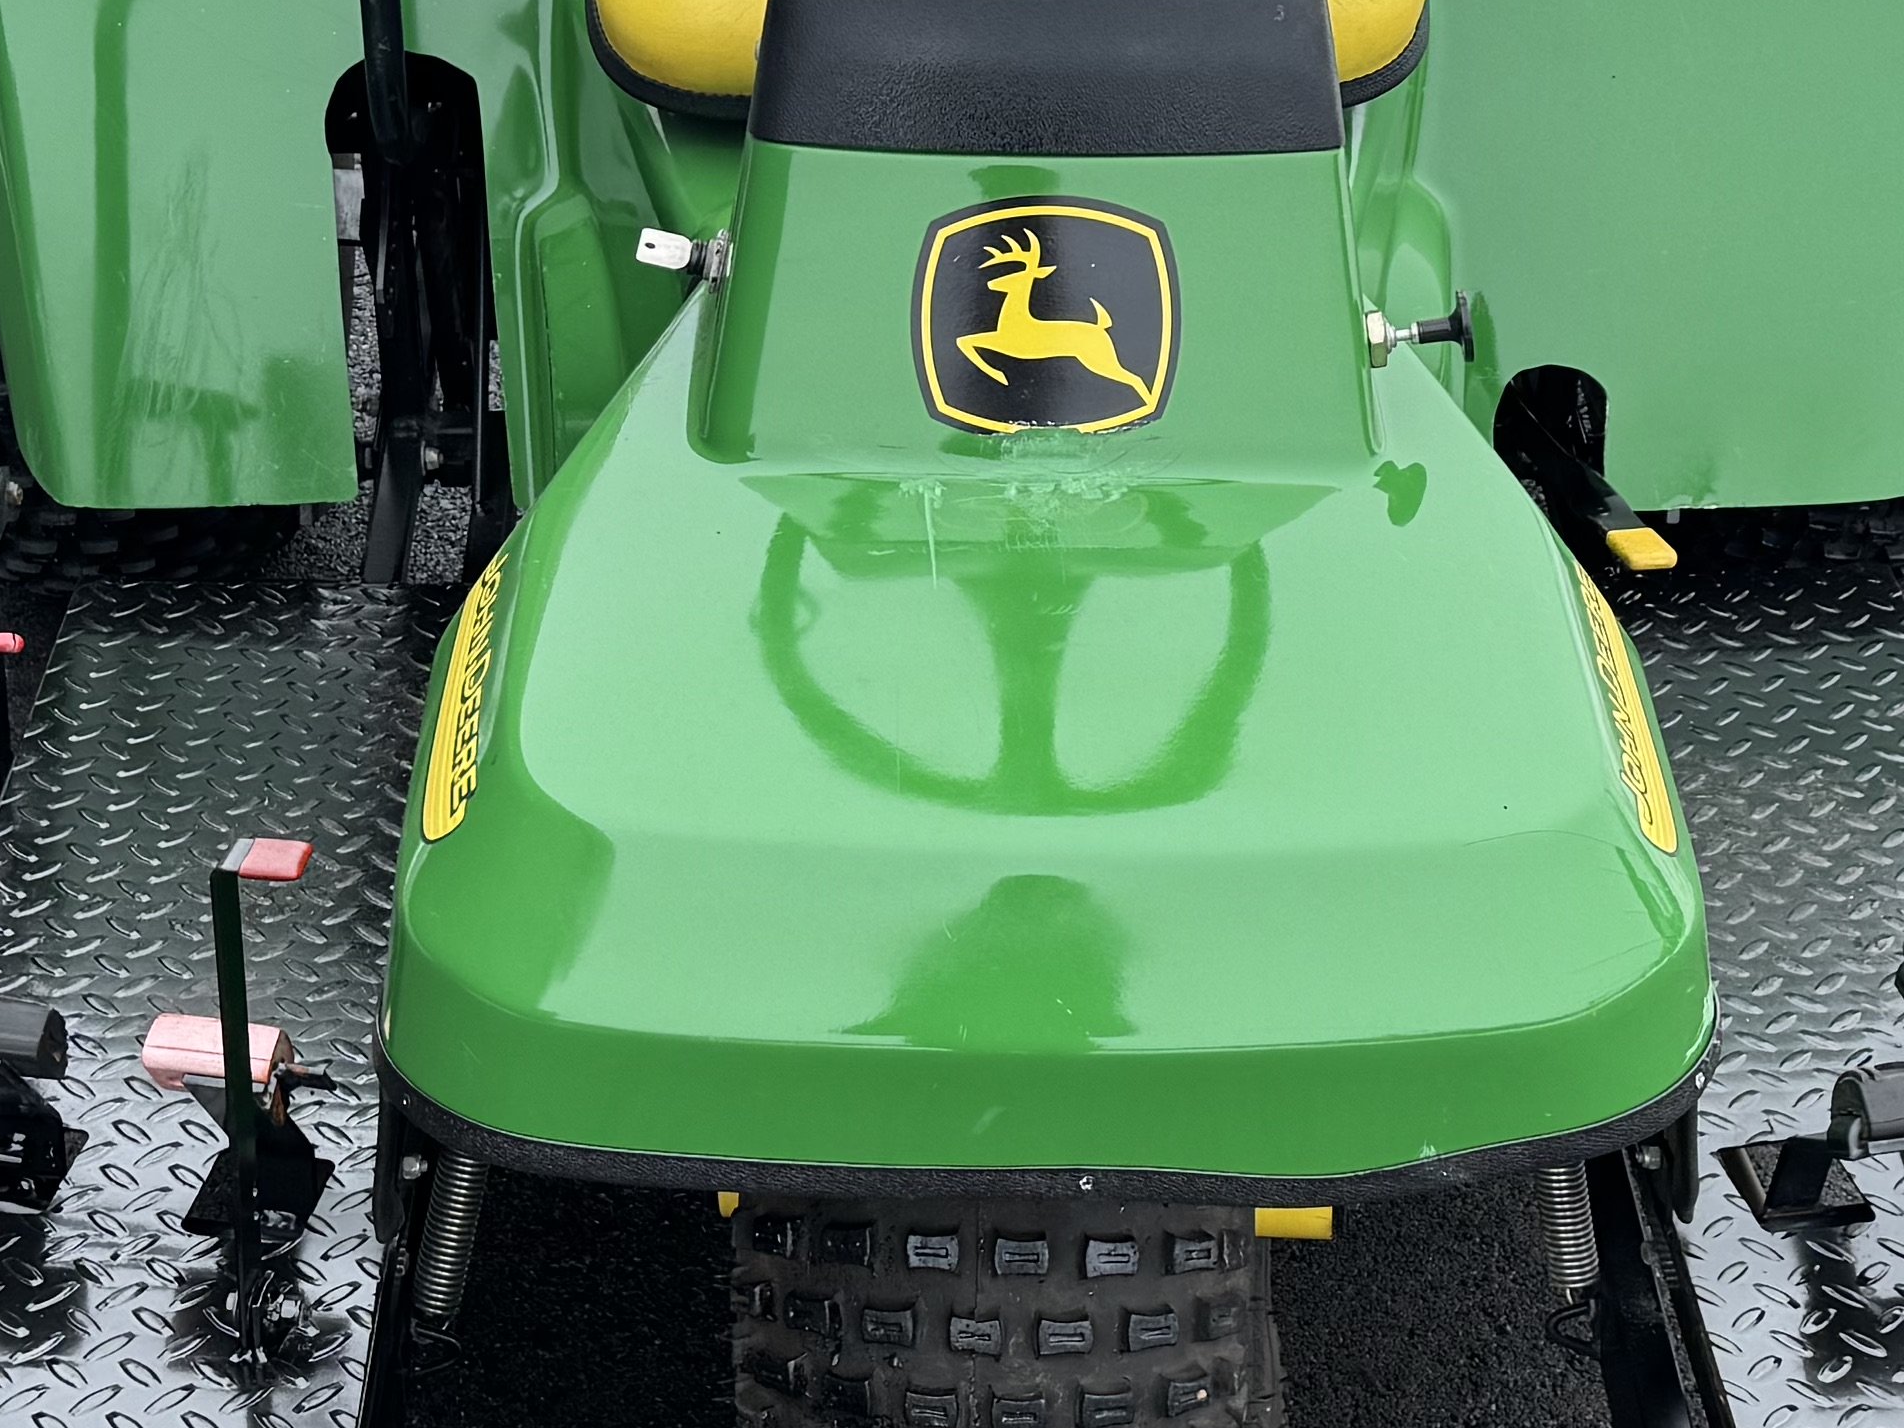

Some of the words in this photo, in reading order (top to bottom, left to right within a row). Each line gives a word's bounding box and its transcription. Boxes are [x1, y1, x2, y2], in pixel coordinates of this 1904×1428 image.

[465, 552, 509, 673] JOHN
[450, 647, 492, 818] DEERE
[1607, 691, 1653, 825] JOHN
